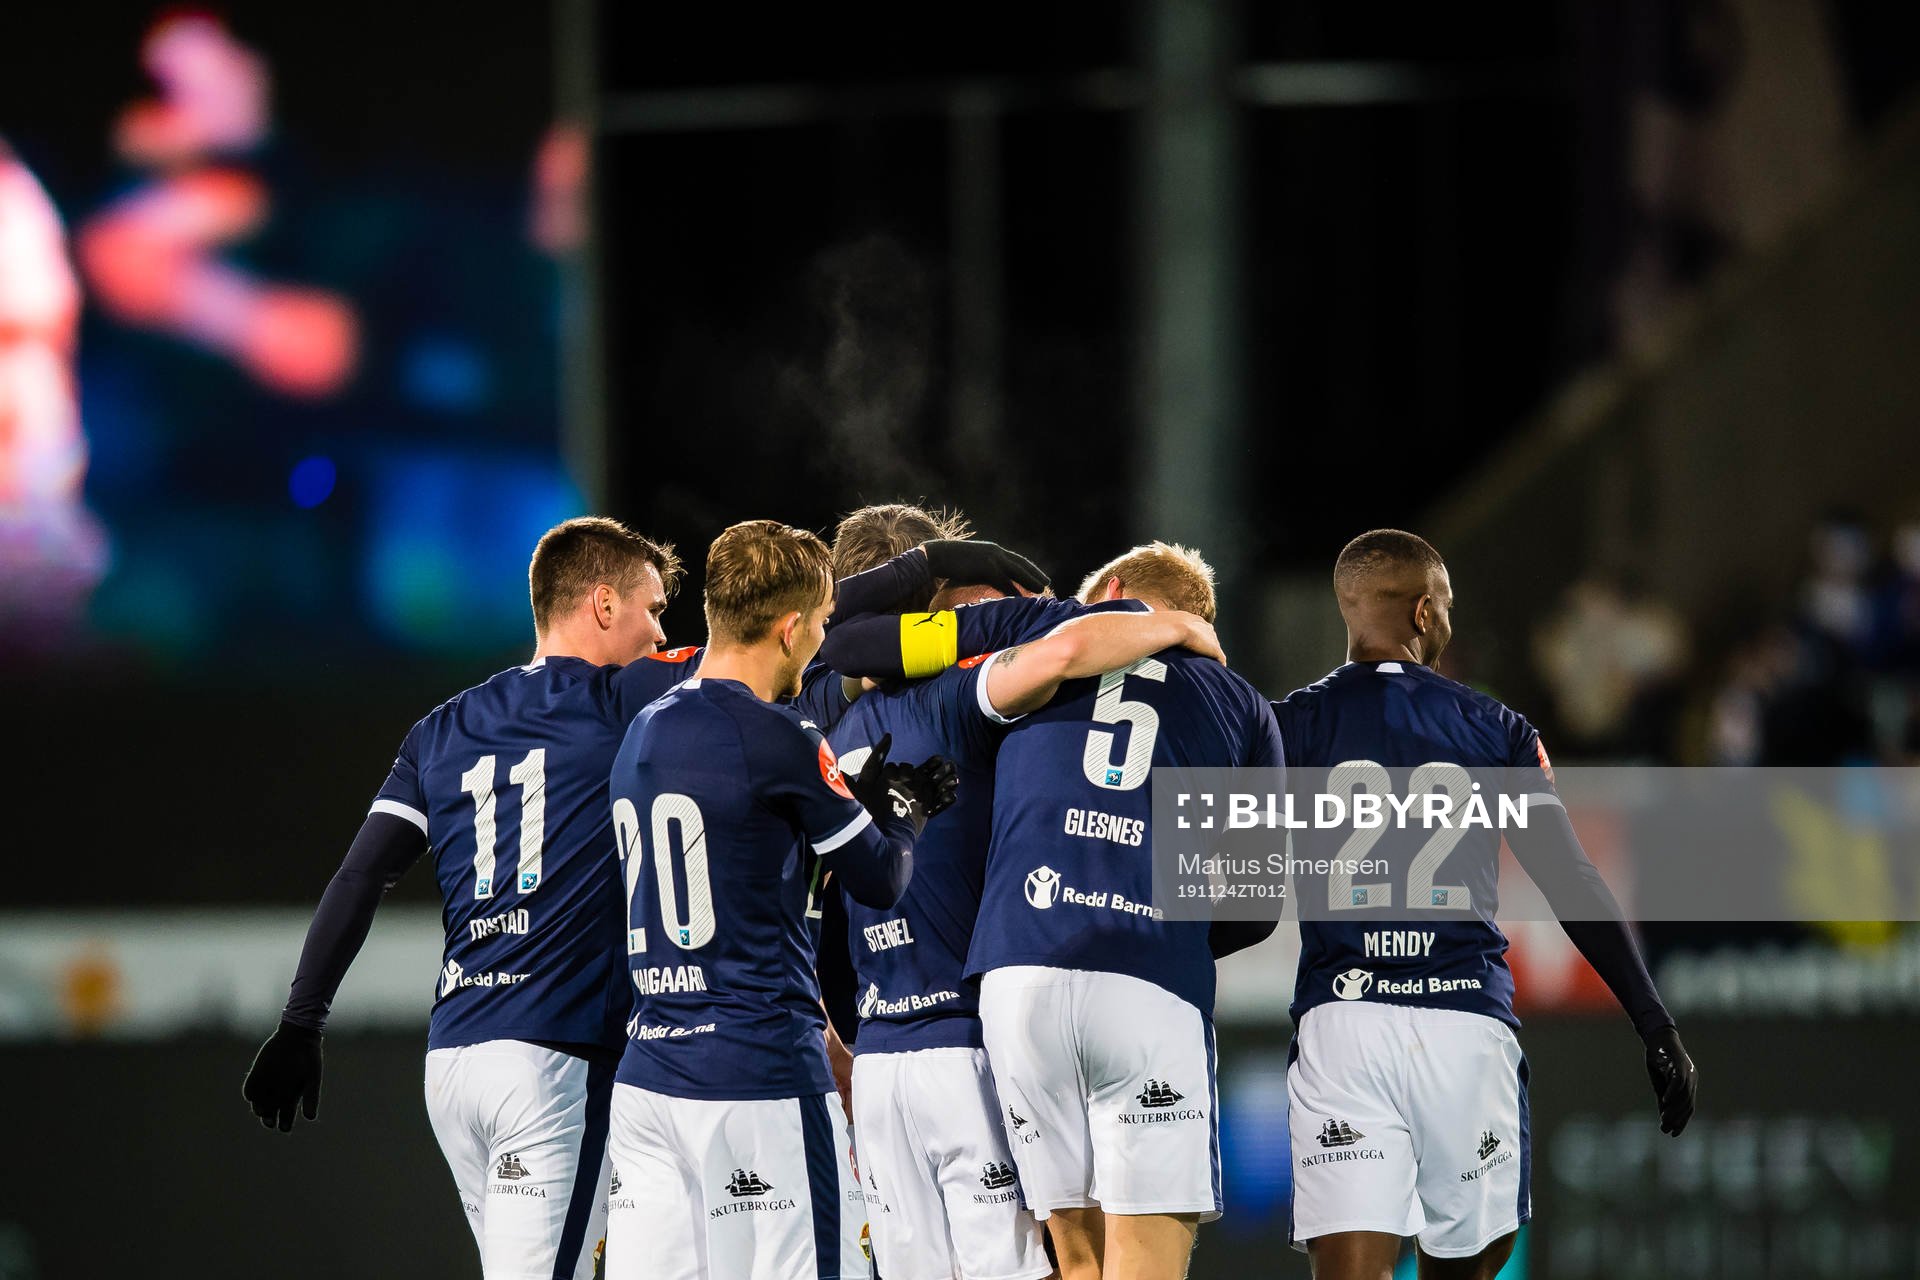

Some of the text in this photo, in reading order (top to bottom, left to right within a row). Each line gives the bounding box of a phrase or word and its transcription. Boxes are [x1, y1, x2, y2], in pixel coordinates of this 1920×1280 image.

[1083, 658, 1168, 791] 5
[462, 748, 546, 900] 11
[1064, 808, 1145, 847] GLESNES
[1326, 759, 1473, 911] 22
[612, 793, 716, 955] 20
[1063, 887, 1163, 919] Redd Barna
[1363, 931, 1436, 957] MENDY
[1377, 978, 1482, 994] Redd Barna
[876, 990, 961, 1015] Redd Barna
[638, 1025, 671, 1040] Redd
[1118, 1109, 1205, 1124] SKUTEBRYGGA
[1301, 1150, 1385, 1168] SKUTEBRYGGA
[710, 1199, 796, 1219] SKUTEBRYGGA
[973, 1190, 1021, 1205] SKUTEBRY
